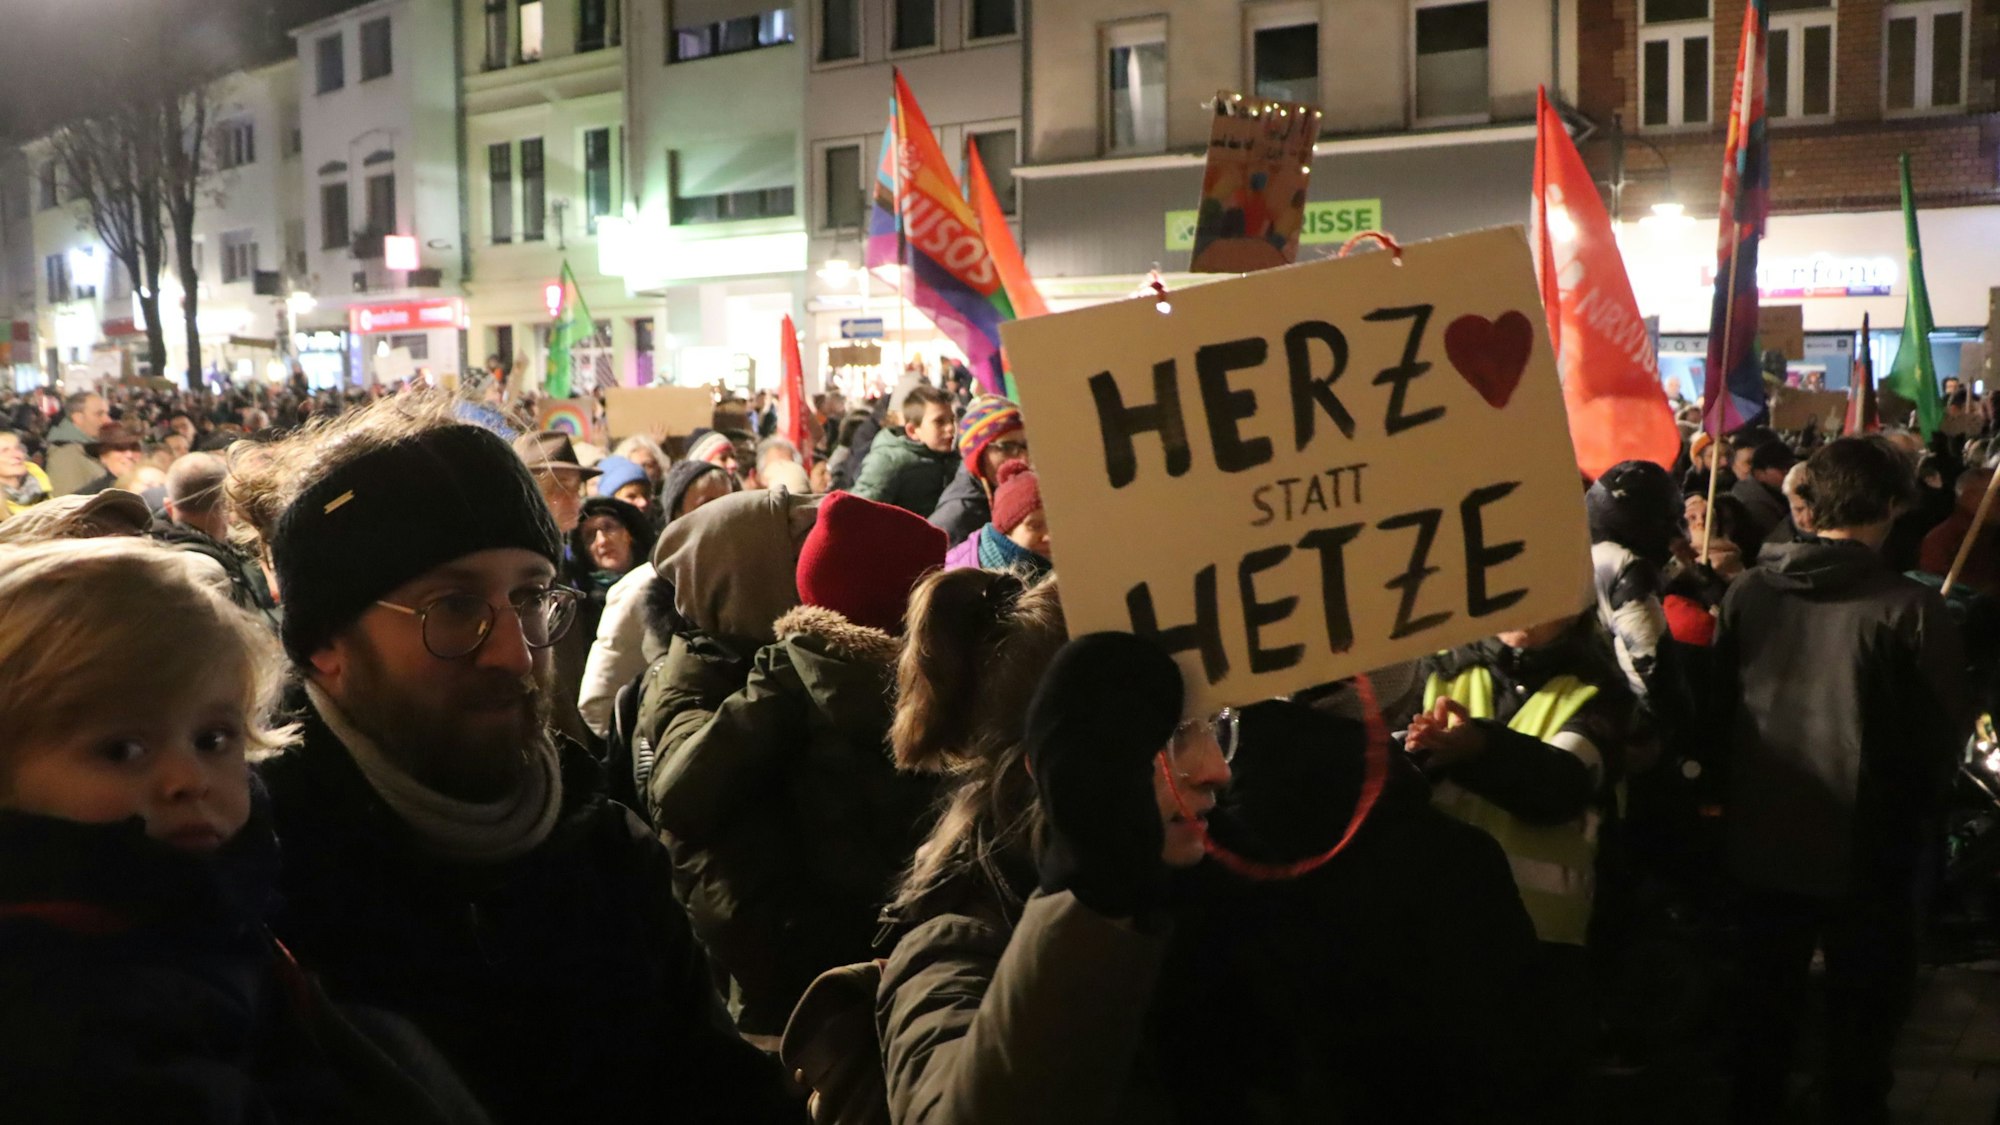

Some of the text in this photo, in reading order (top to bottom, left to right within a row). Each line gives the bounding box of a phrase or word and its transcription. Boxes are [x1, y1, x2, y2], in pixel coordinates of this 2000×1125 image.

[1088, 303, 1446, 490] HERZ
[1125, 480, 1531, 686] HETZE
[1251, 463, 1369, 527] STATT
